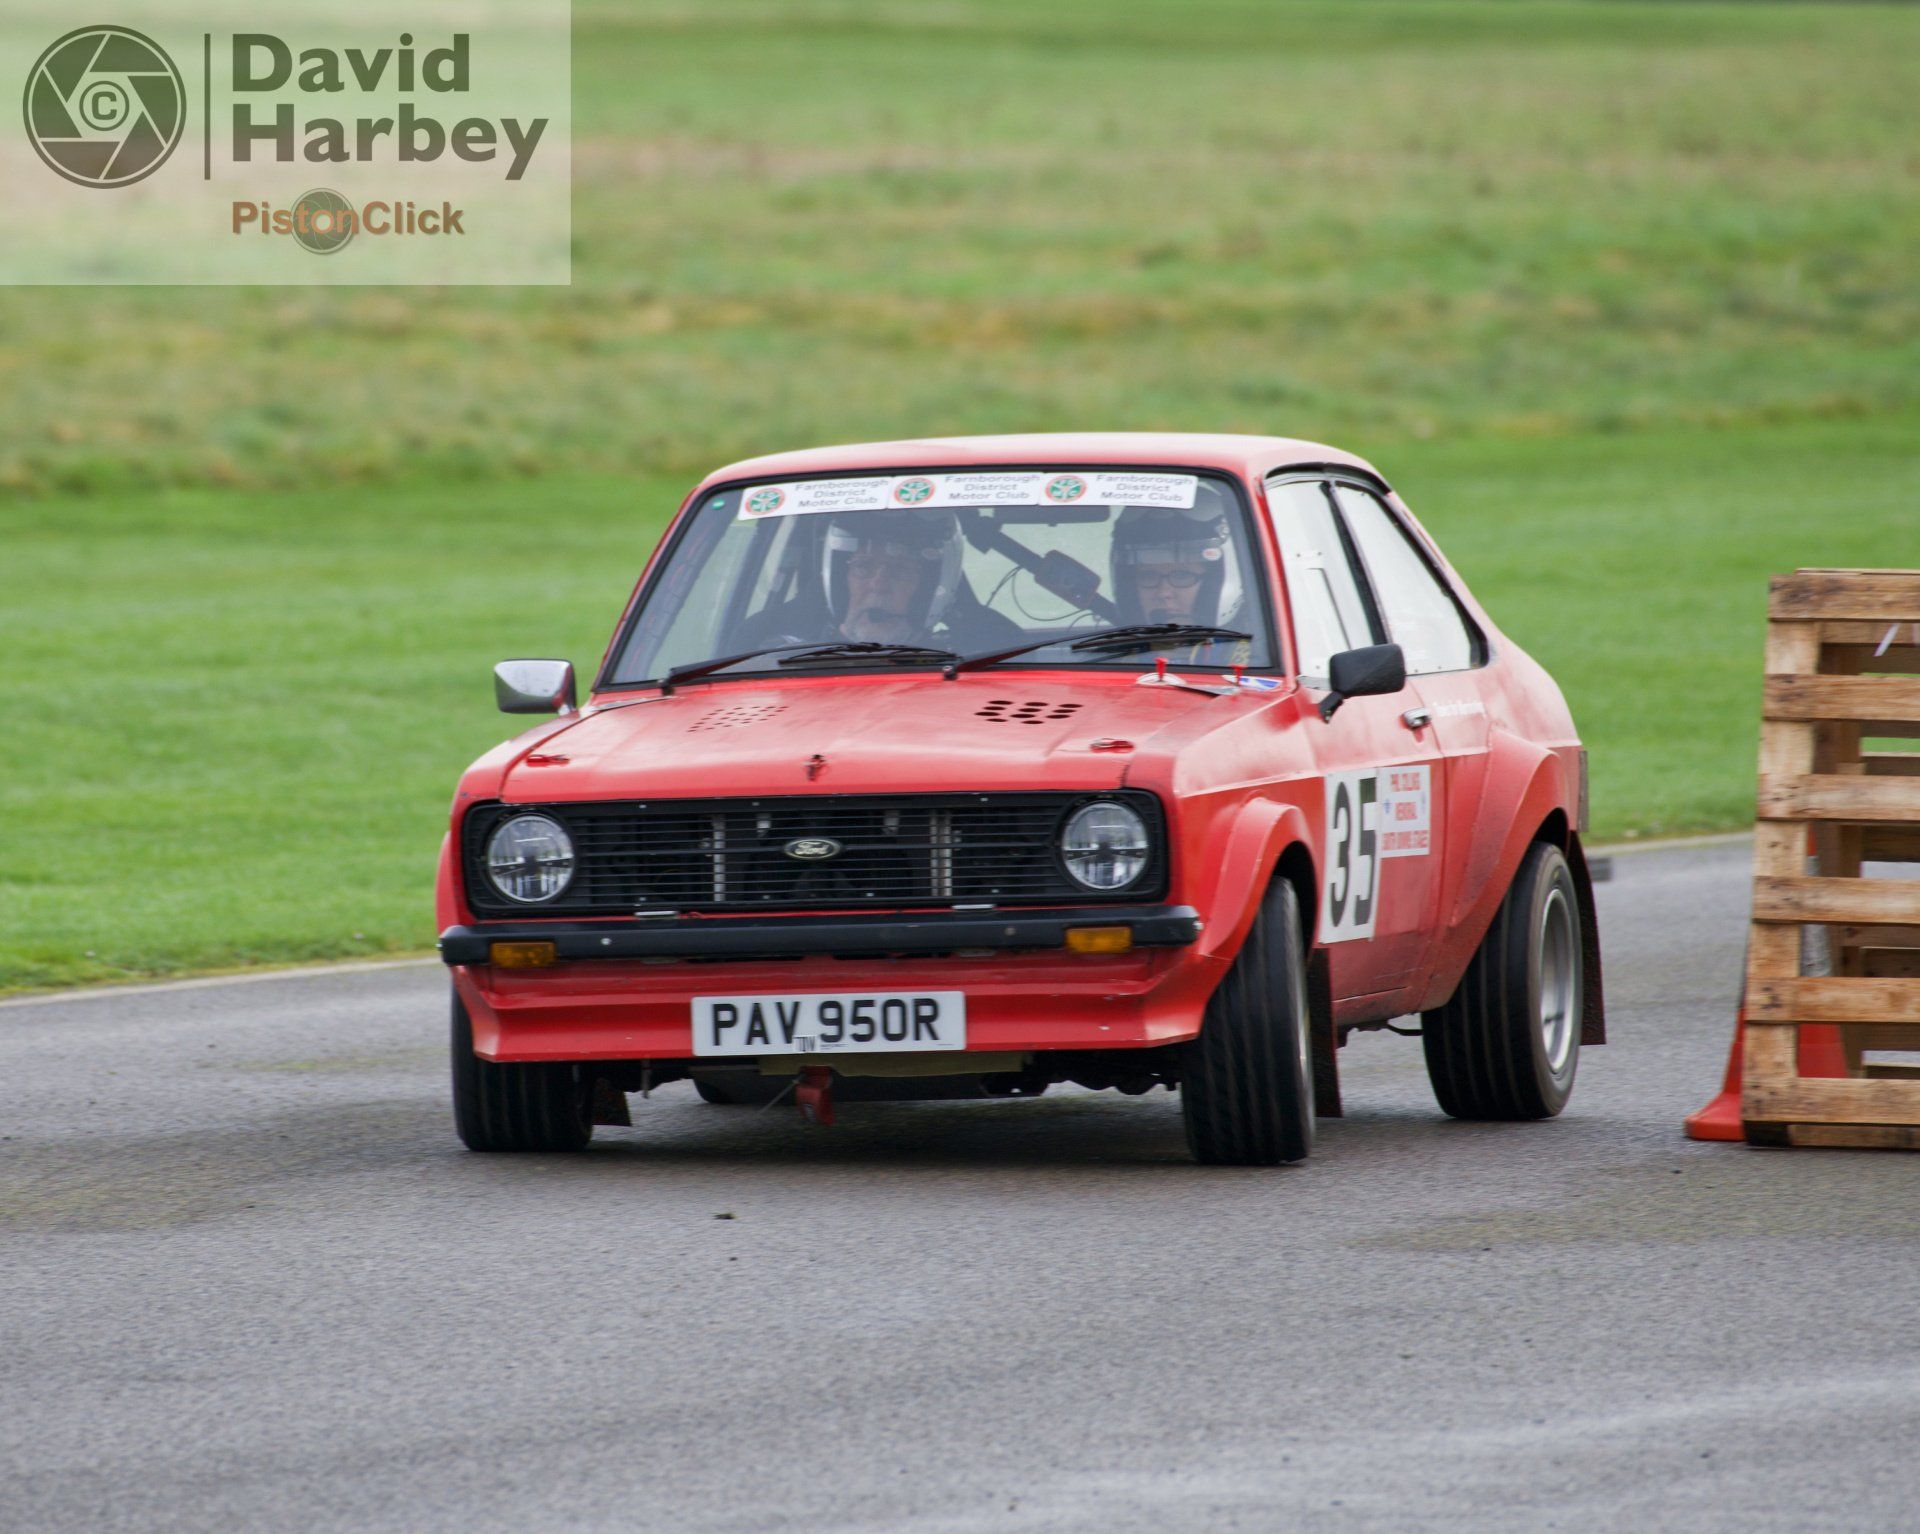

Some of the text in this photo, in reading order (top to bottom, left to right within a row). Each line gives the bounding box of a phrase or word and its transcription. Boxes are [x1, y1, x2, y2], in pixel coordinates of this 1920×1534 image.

[964, 483, 1018, 491] District
[1116, 483, 1170, 492] District
[814, 489, 866, 498] District
[995, 491, 1030, 499] Club
[1100, 491, 1184, 502] Motor Club
[798, 497, 878, 507] Motor Club
[1331, 777, 1376, 927] 35
[712, 998, 940, 1046] PAV 950R
